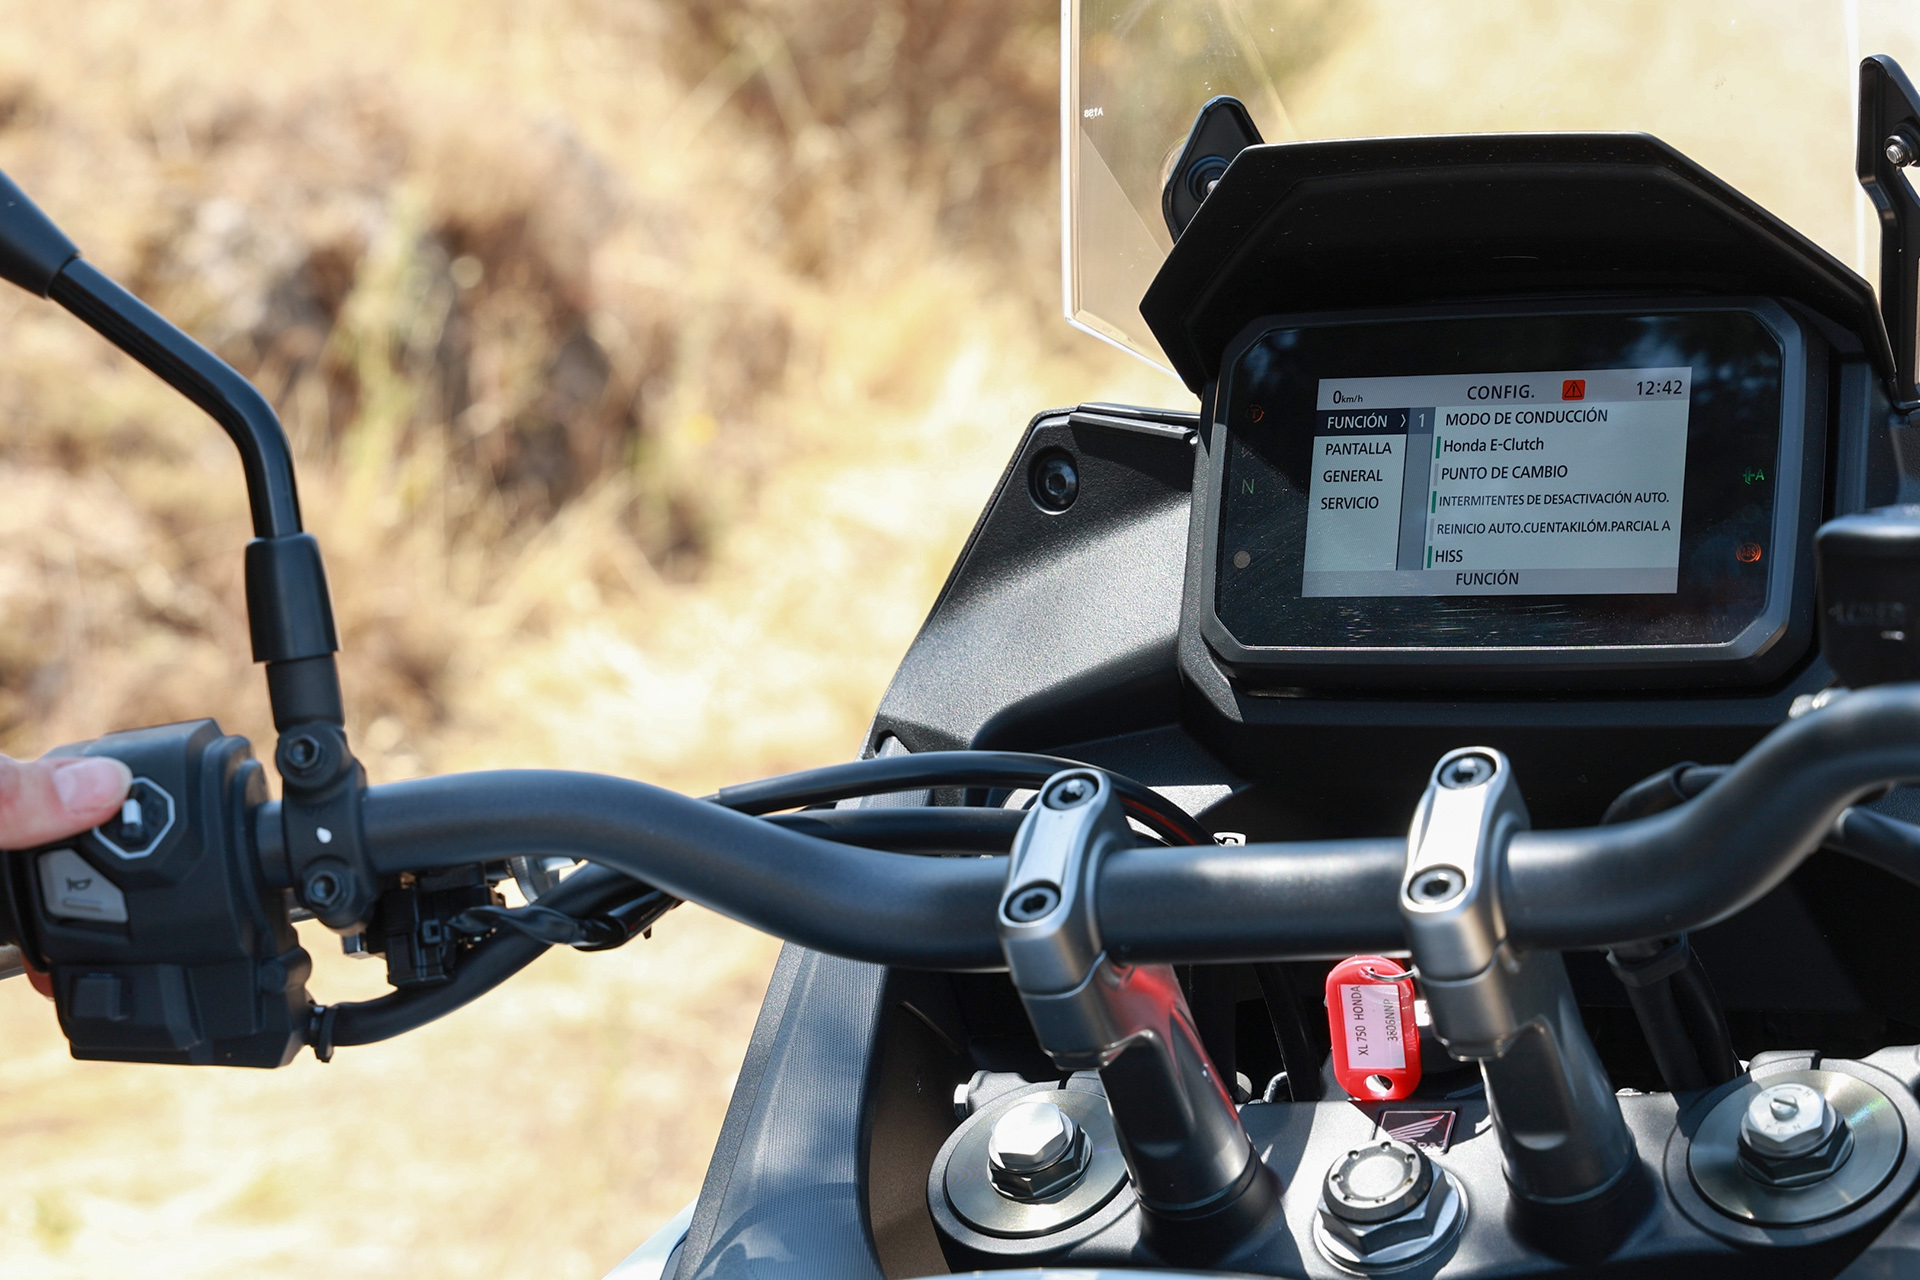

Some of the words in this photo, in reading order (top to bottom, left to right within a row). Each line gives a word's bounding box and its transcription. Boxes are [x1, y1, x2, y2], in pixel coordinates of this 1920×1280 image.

[1467, 385, 1535, 400] CONFIG.
[1637, 381, 1682, 395] 12:42
[1327, 415, 1388, 429] FUNCIÓN
[1418, 414, 1425, 427] 1
[1446, 412, 1490, 426] MODO
[1495, 412, 1511, 425] DE
[1515, 409, 1608, 424] CONDUCCIÓN
[1325, 442, 1392, 455] PANTALLA
[1444, 438, 1486, 452] Honda
[1490, 437, 1544, 451] E-Clutch
[1323, 470, 1383, 483] GENERAL
[1441, 467, 1487, 480] PUNTO
[1491, 466, 1508, 479] DE
[1512, 465, 1568, 478] CAMBIO
[1242, 479, 1255, 494] N
[1321, 497, 1379, 510] SERVICIO
[1439, 494, 1524, 507] INTERMITENTES
[1527, 494, 1541, 505] DE
[1544, 491, 1632, 504] DESACTIVACIÓN
[1635, 492, 1669, 503] AUTO.
[1437, 522, 1485, 535] REINICIO
[1661, 520, 1670, 531] A
[1435, 550, 1463, 563] HISS
[1456, 570, 1519, 585] FUNCIÓN
[1350, 985, 1365, 1020] HONDA
[1357, 1026, 1367, 1041] 750
[1358, 1045, 1368, 1056] XL
